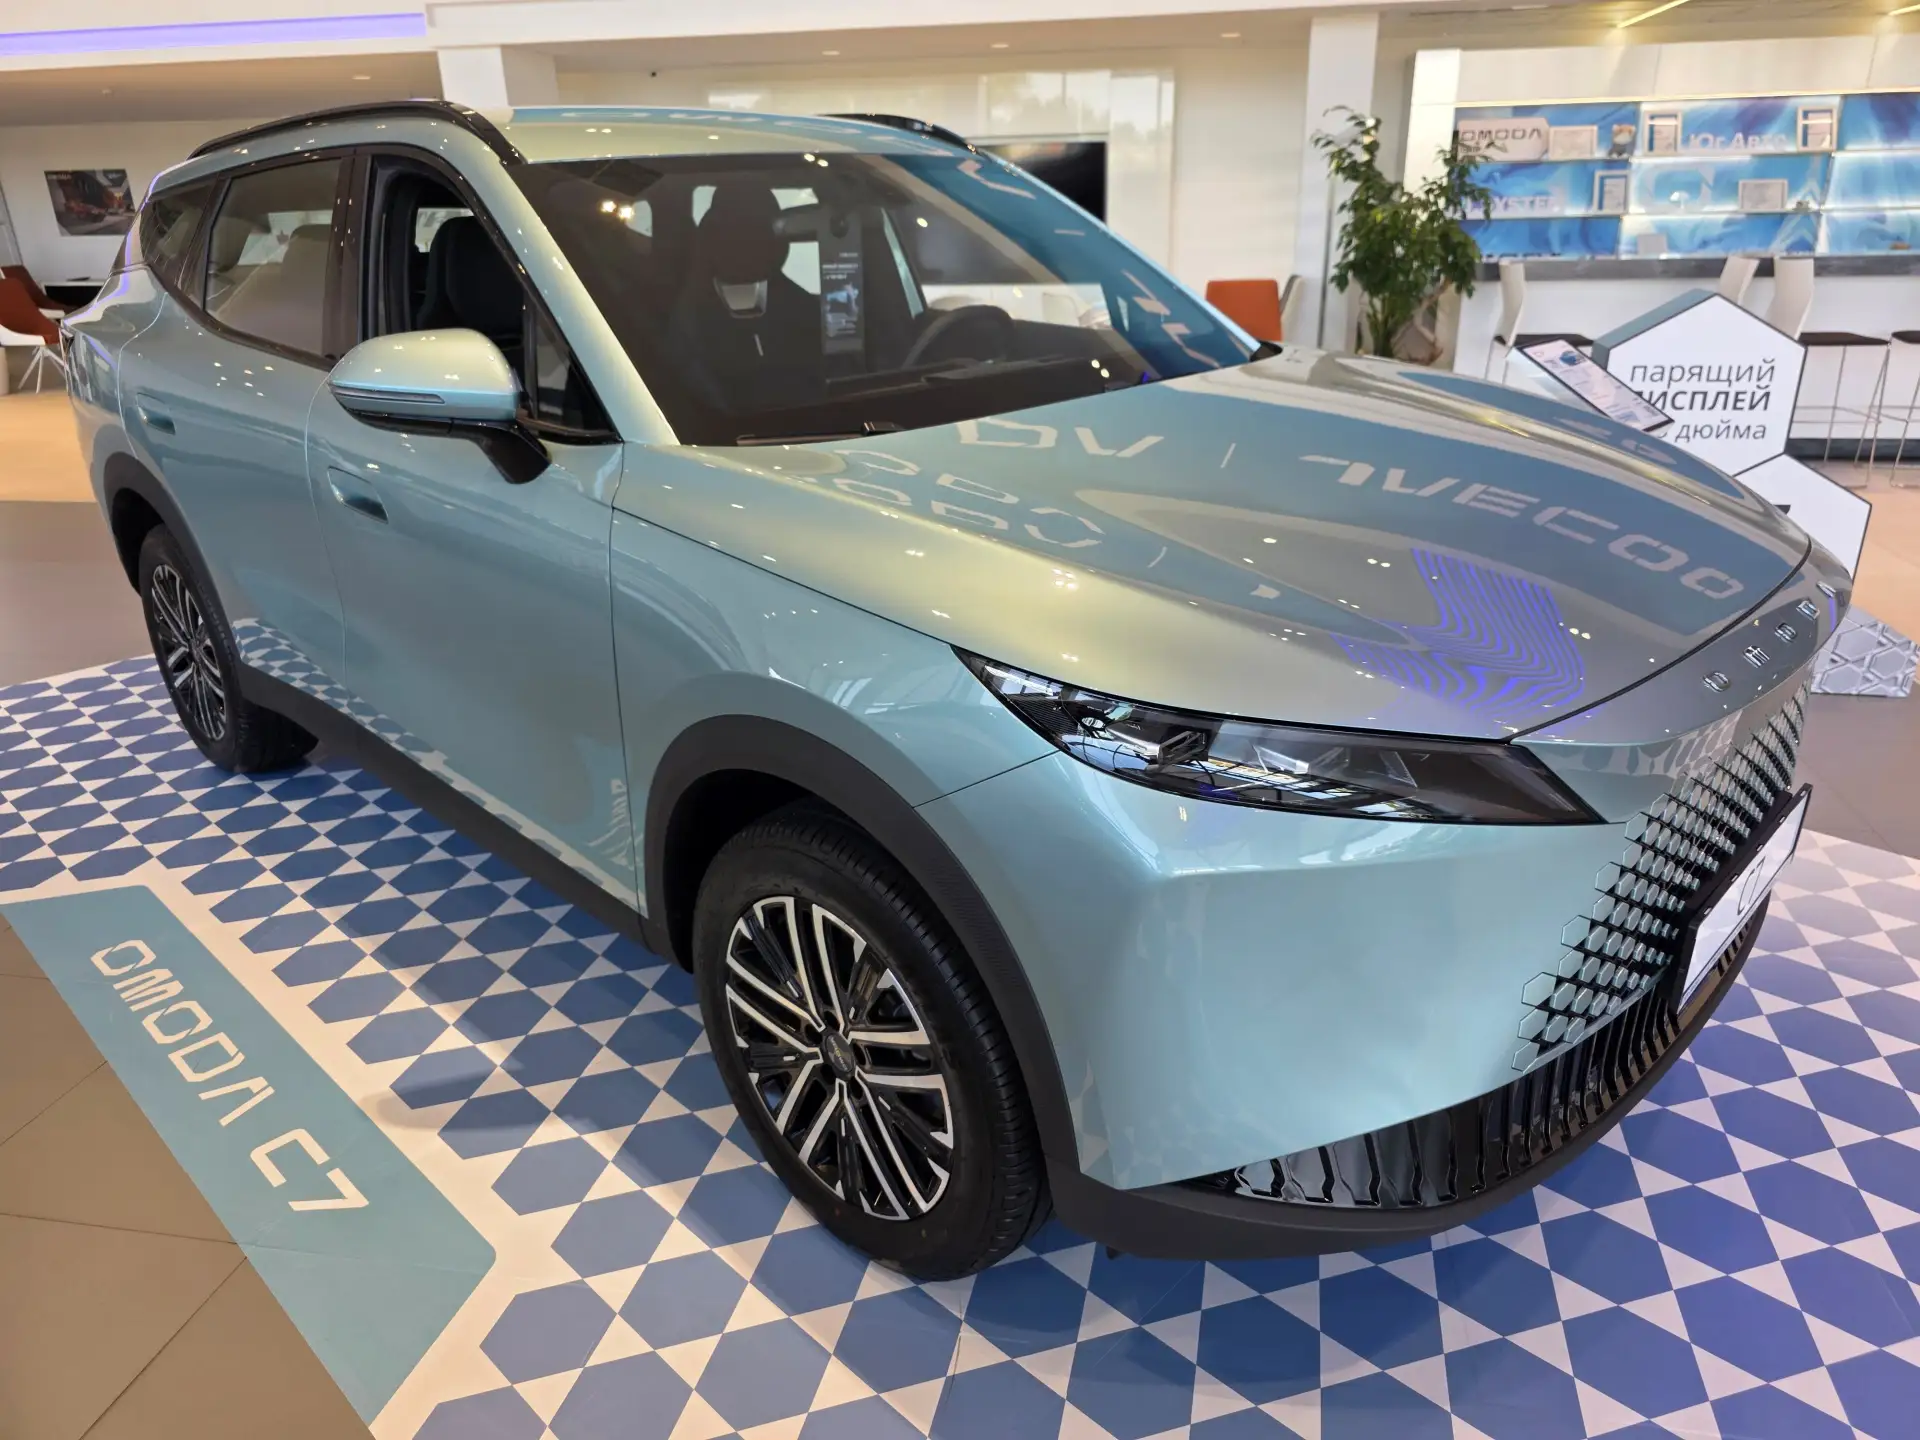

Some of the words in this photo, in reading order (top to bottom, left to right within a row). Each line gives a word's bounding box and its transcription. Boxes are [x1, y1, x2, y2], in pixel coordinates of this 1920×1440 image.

[1461, 127, 1542, 142] OMODA
[1689, 132, 1726, 149] Юг
[1630, 357, 1775, 388] парящий
[1676, 420, 1767, 442] дюйма
[90, 940, 275, 1127] OMODA
[250, 1128, 369, 1211] C7
